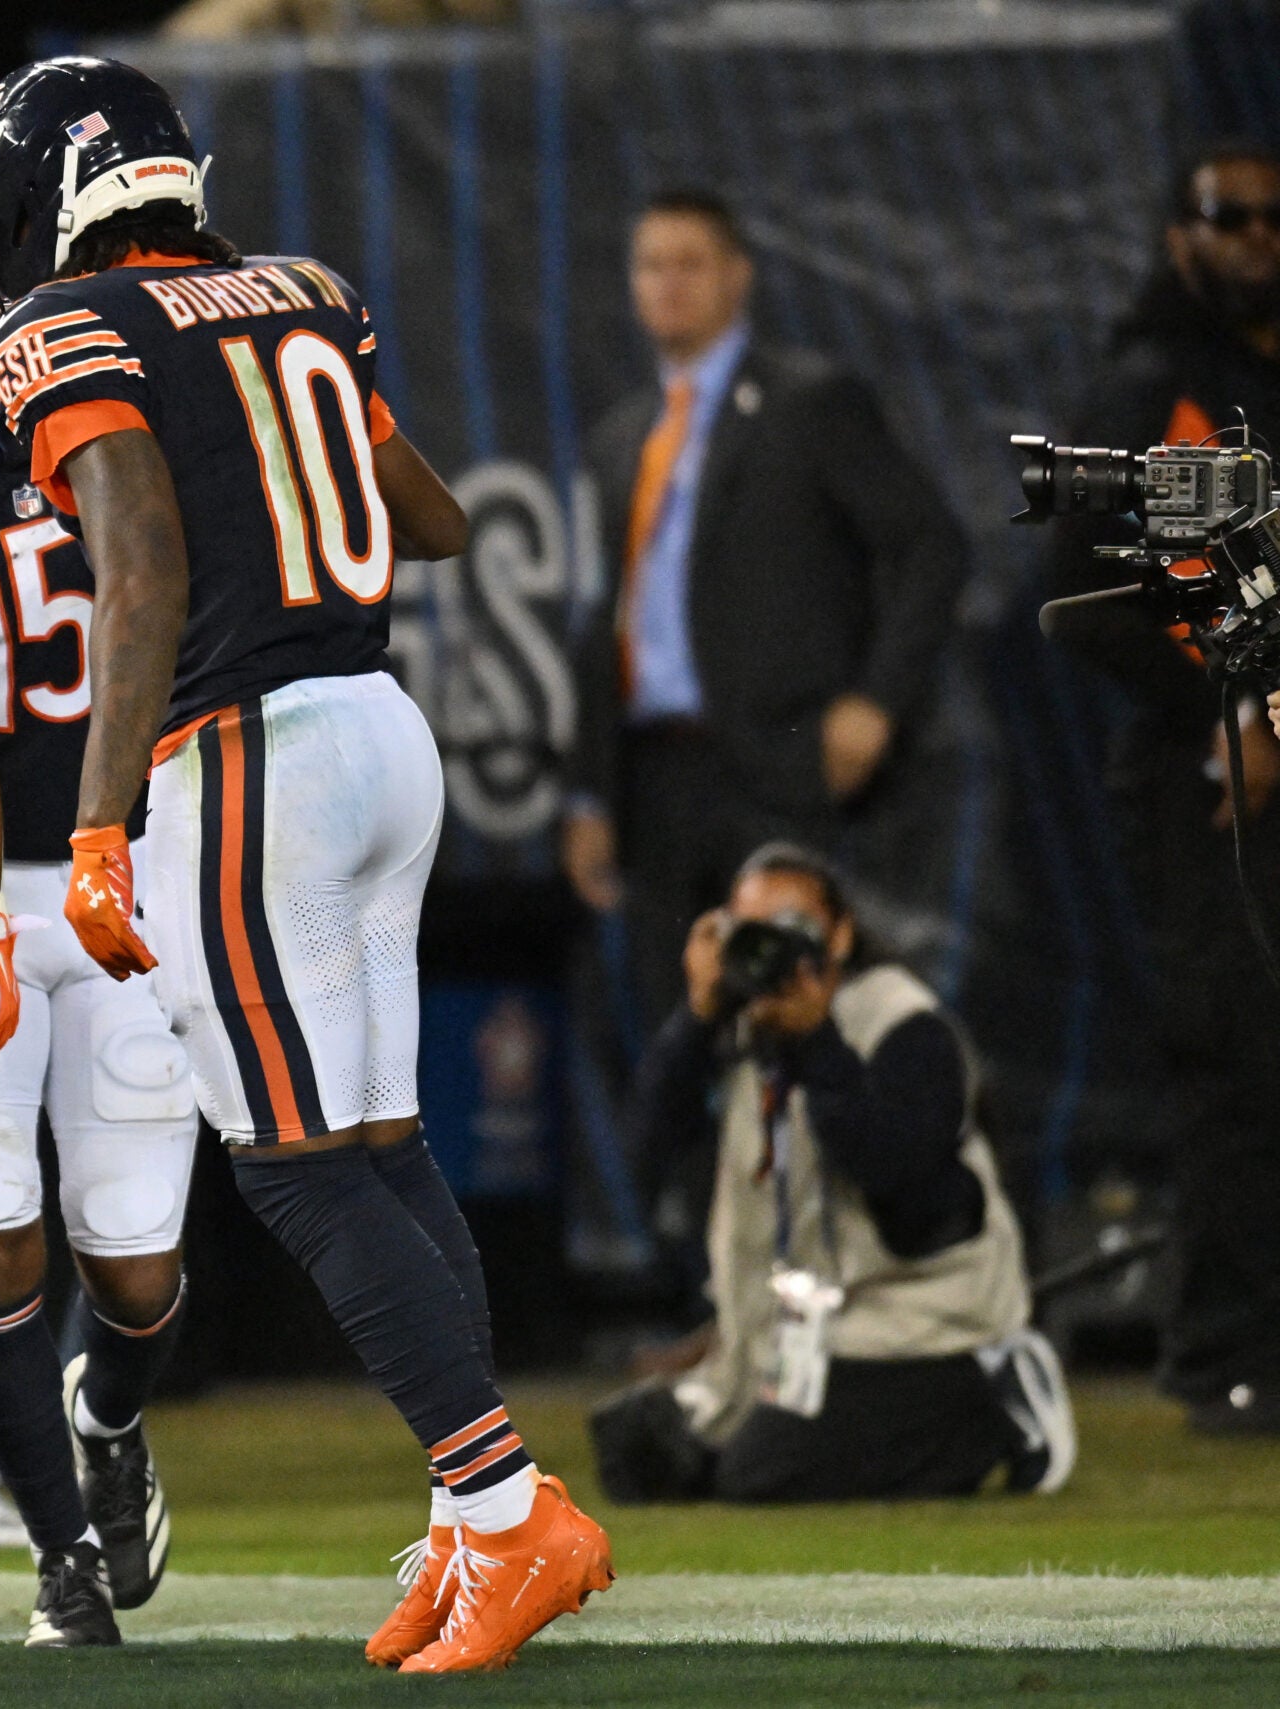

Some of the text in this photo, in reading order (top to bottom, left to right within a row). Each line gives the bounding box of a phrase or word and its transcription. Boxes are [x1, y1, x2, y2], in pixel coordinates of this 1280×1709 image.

[135, 164, 188, 180] BEARS
[138, 264, 316, 332] BURDEN
[218, 328, 393, 607] 10
